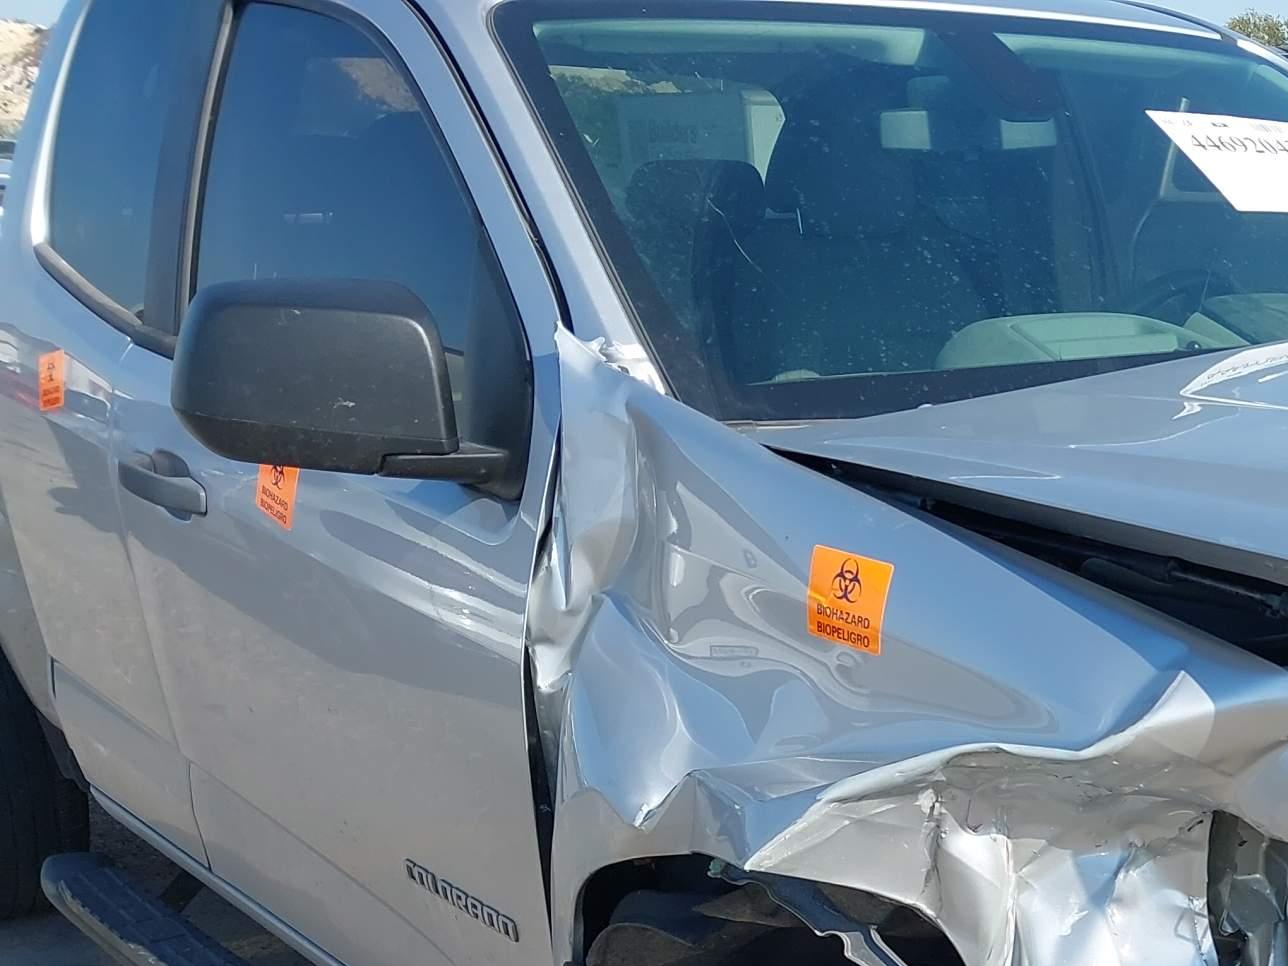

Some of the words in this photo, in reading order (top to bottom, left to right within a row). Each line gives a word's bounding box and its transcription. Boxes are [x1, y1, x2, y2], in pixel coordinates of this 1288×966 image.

[261, 484, 289, 511] BIOHAZARD
[260, 498, 287, 525] BIOPELIGRO
[816, 603, 871, 630] BIOHAZARD
[816, 621, 871, 648] BIOPELIGRO
[405, 858, 520, 943] COLORADO
